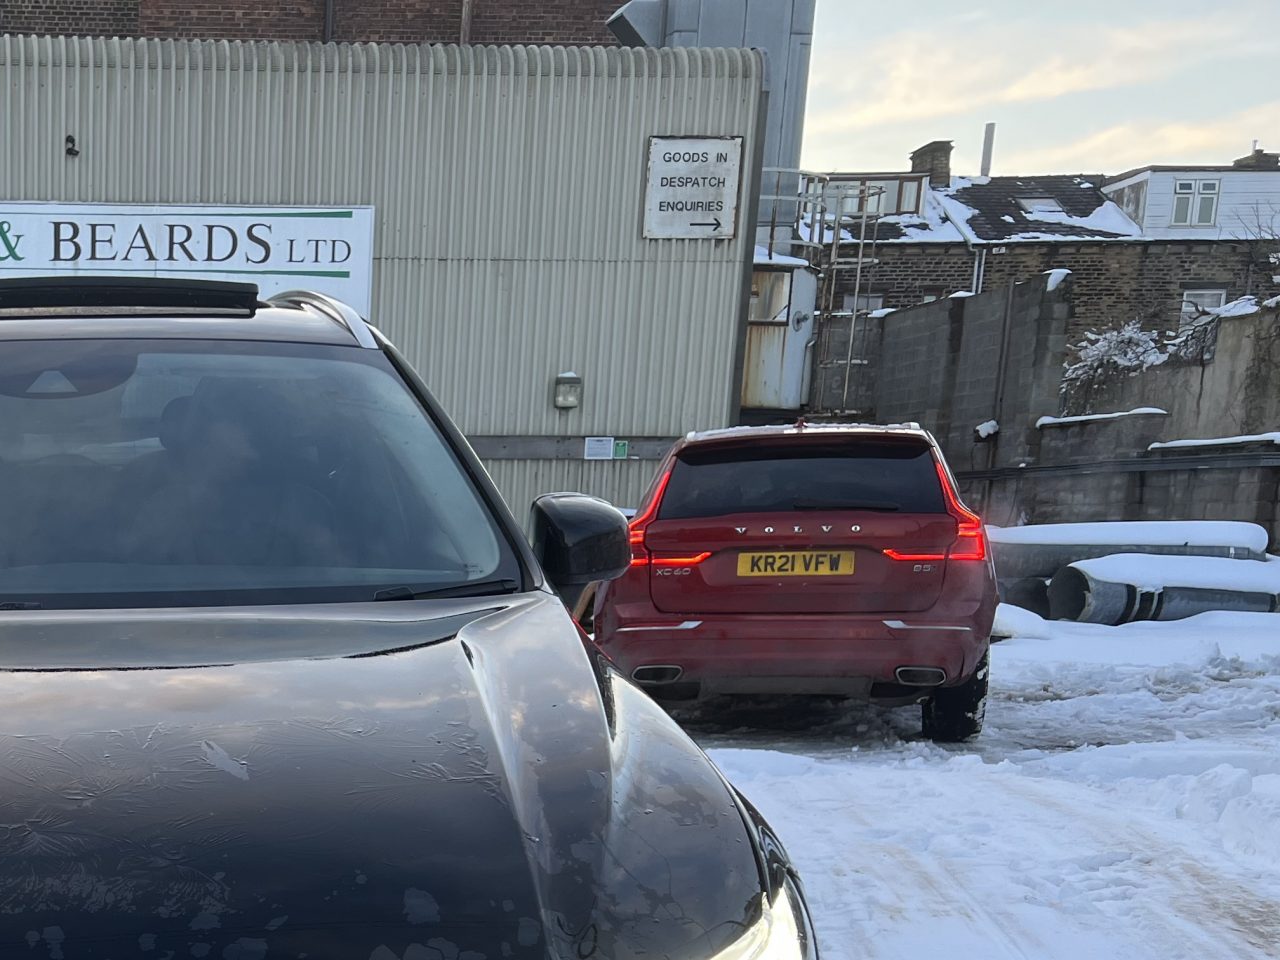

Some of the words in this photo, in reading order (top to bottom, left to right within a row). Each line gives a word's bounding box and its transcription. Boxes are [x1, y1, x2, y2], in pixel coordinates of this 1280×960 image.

[662, 152, 709, 163] GOODS
[716, 152, 728, 163] IN
[660, 176, 726, 188] DESPATCH
[658, 200, 724, 212] ENQUIRIES
[48, 220, 273, 264] BEARDS
[286, 238, 352, 264] LTD
[735, 525, 861, 534] VOLVO
[750, 554, 796, 573] KR21
[802, 553, 842, 572] VFW
